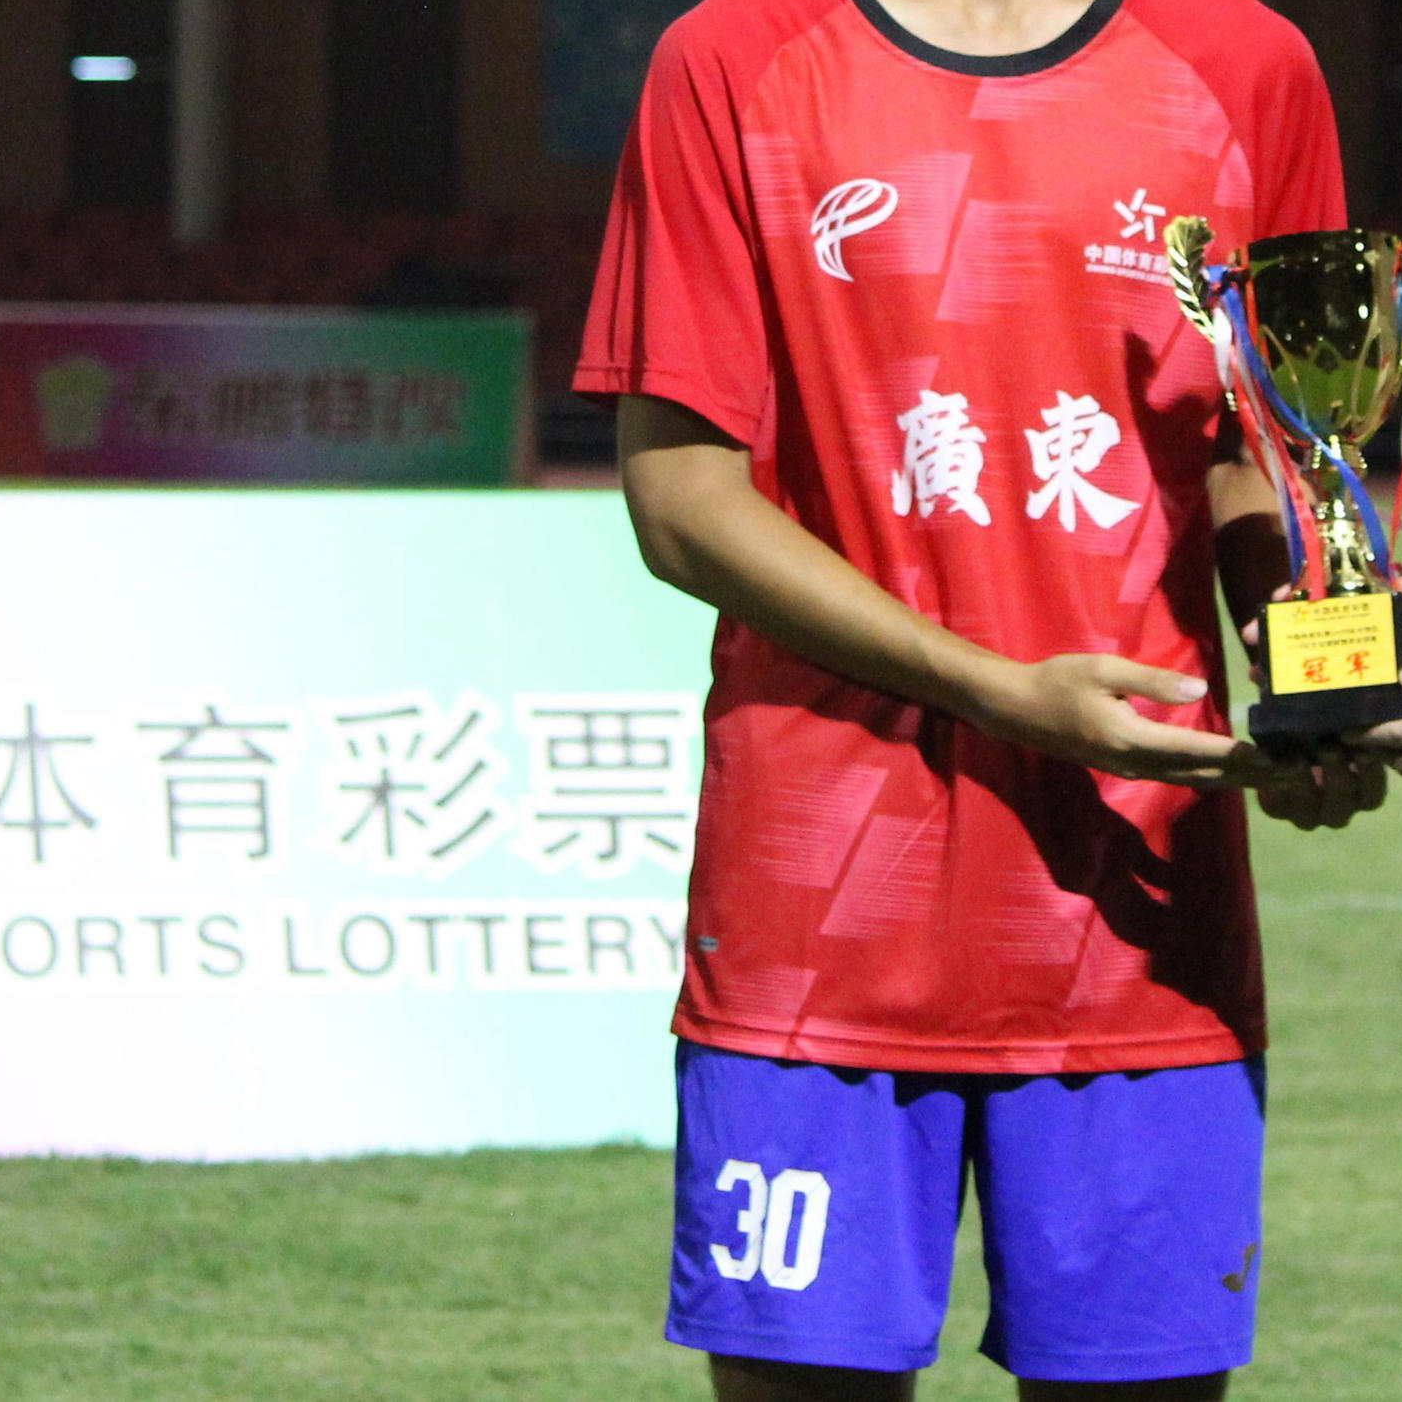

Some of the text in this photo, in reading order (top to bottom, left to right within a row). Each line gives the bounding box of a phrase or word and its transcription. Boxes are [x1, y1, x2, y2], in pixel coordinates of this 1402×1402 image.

[1083, 243, 1172, 275] 中国体育彩
[891, 389, 1141, 532] 廣東
[285, 914, 687, 975] LOTTERY
[710, 1159, 832, 1292] 30
